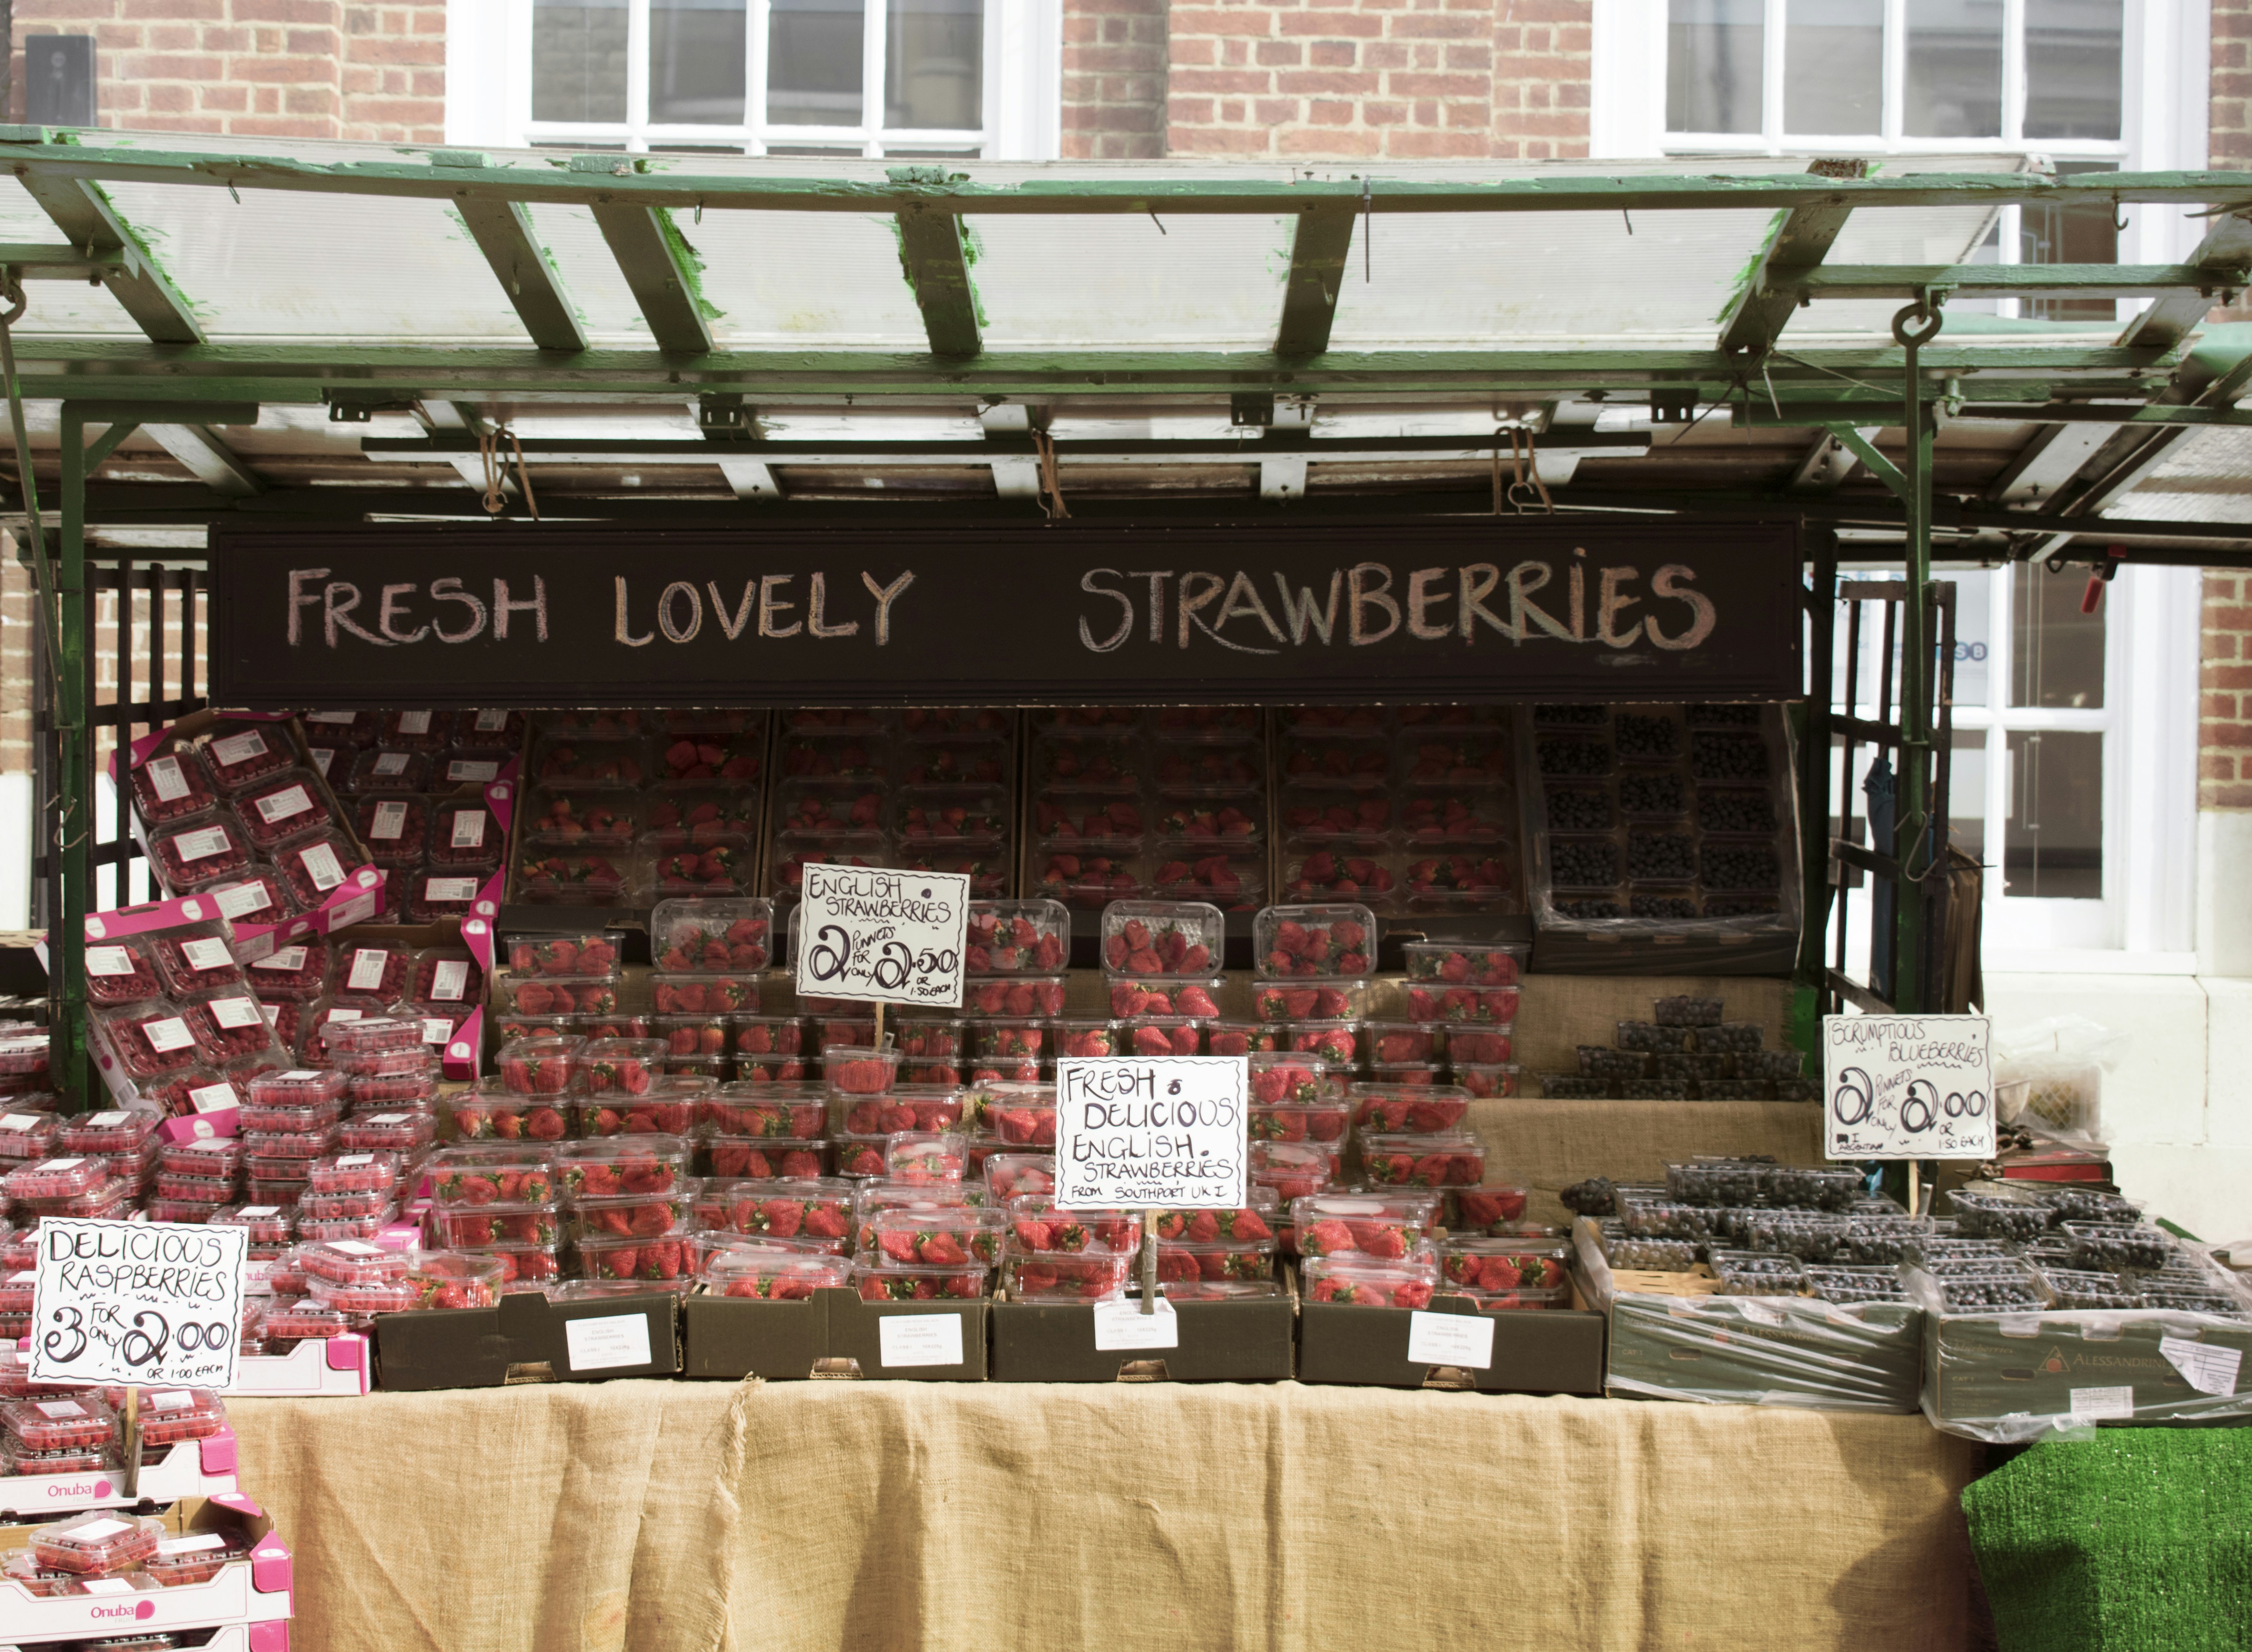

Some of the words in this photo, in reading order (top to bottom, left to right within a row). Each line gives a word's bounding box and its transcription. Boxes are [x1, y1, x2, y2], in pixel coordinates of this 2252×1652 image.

[287, 568, 548, 649] FRESH
[614, 569, 918, 648] LOVELY
[1078, 547, 1719, 655] STRAWBERRIES
[809, 874, 901, 903] ENGLISH
[826, 897, 951, 923] STRAWBERRIES
[853, 926, 895, 950] PUNNETS
[809, 925, 850, 982] 2
[852, 950, 871, 966] FOR
[874, 942, 958, 989] 2.50
[851, 967, 875, 986] ONLY
[917, 976, 930, 985] OR
[929, 984, 951, 996] EACH
[1832, 1022, 1925, 1047] SCRUMPTIOUS
[1888, 1041, 1985, 1067] BLUEBERRIES
[1067, 1067, 1156, 1102] FRESH
[1834, 1067, 1873, 1125] 2
[1875, 1069, 1912, 1098] PUNNETS
[1085, 1097, 1234, 1130] DELICIOUS
[1877, 1094, 1897, 1115] FOR
[1901, 1079, 1986, 1133] 2.00
[1871, 1117, 1896, 1139] ONLY
[1939, 1122, 1954, 1136] OR
[1073, 1131, 1194, 1162] ENGLISH
[1961, 1136, 1984, 1148] EACH
[1084, 1159, 1233, 1182] STRAWBERRIES
[1072, 1185, 1102, 1198] FROM
[1115, 1185, 1185, 1199] SOUTHPORT
[1192, 1186, 1211, 1198] UK
[50, 1229, 222, 1267] DELICIOUS
[60, 1261, 226, 1301] RASPBERRIES
[91, 1302, 127, 1329] FOR
[44, 1307, 87, 1363] 3
[89, 1326, 122, 1359] ONLY
[123, 1311, 229, 1366] 2.00
[147, 1368, 163, 1378] OR
[196, 1365, 223, 1376] EACH
[48, 1483, 92, 1497] Onuba
[91, 1605, 134, 1618] Onuba
